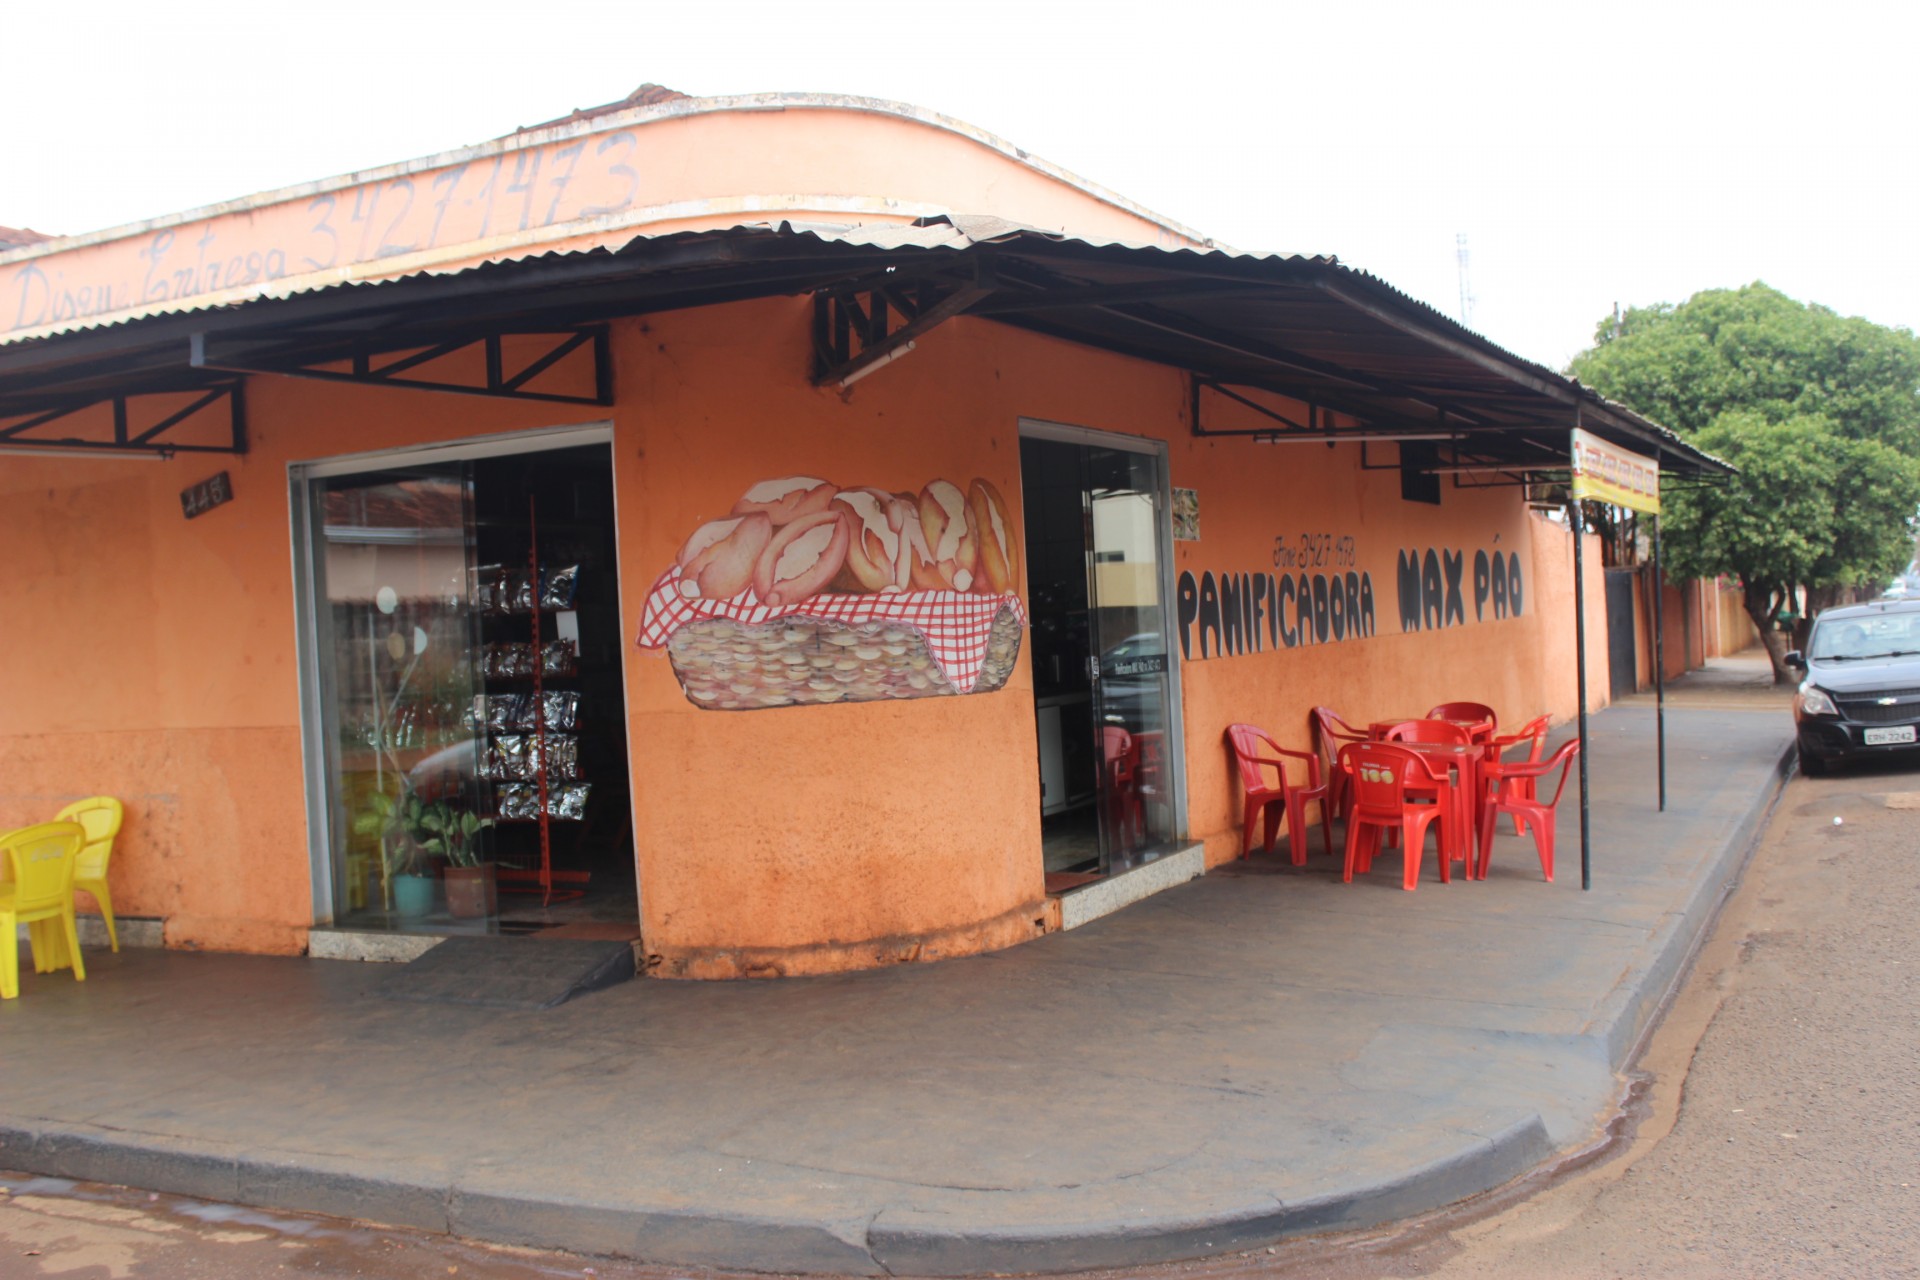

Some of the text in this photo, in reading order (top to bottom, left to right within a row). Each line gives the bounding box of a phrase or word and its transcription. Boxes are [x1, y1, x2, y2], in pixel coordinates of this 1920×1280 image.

[302, 131, 641, 270] 3427-1473
[1177, 570, 1377, 661] PANIFICADORA
[1396, 546, 1466, 634] MAX
